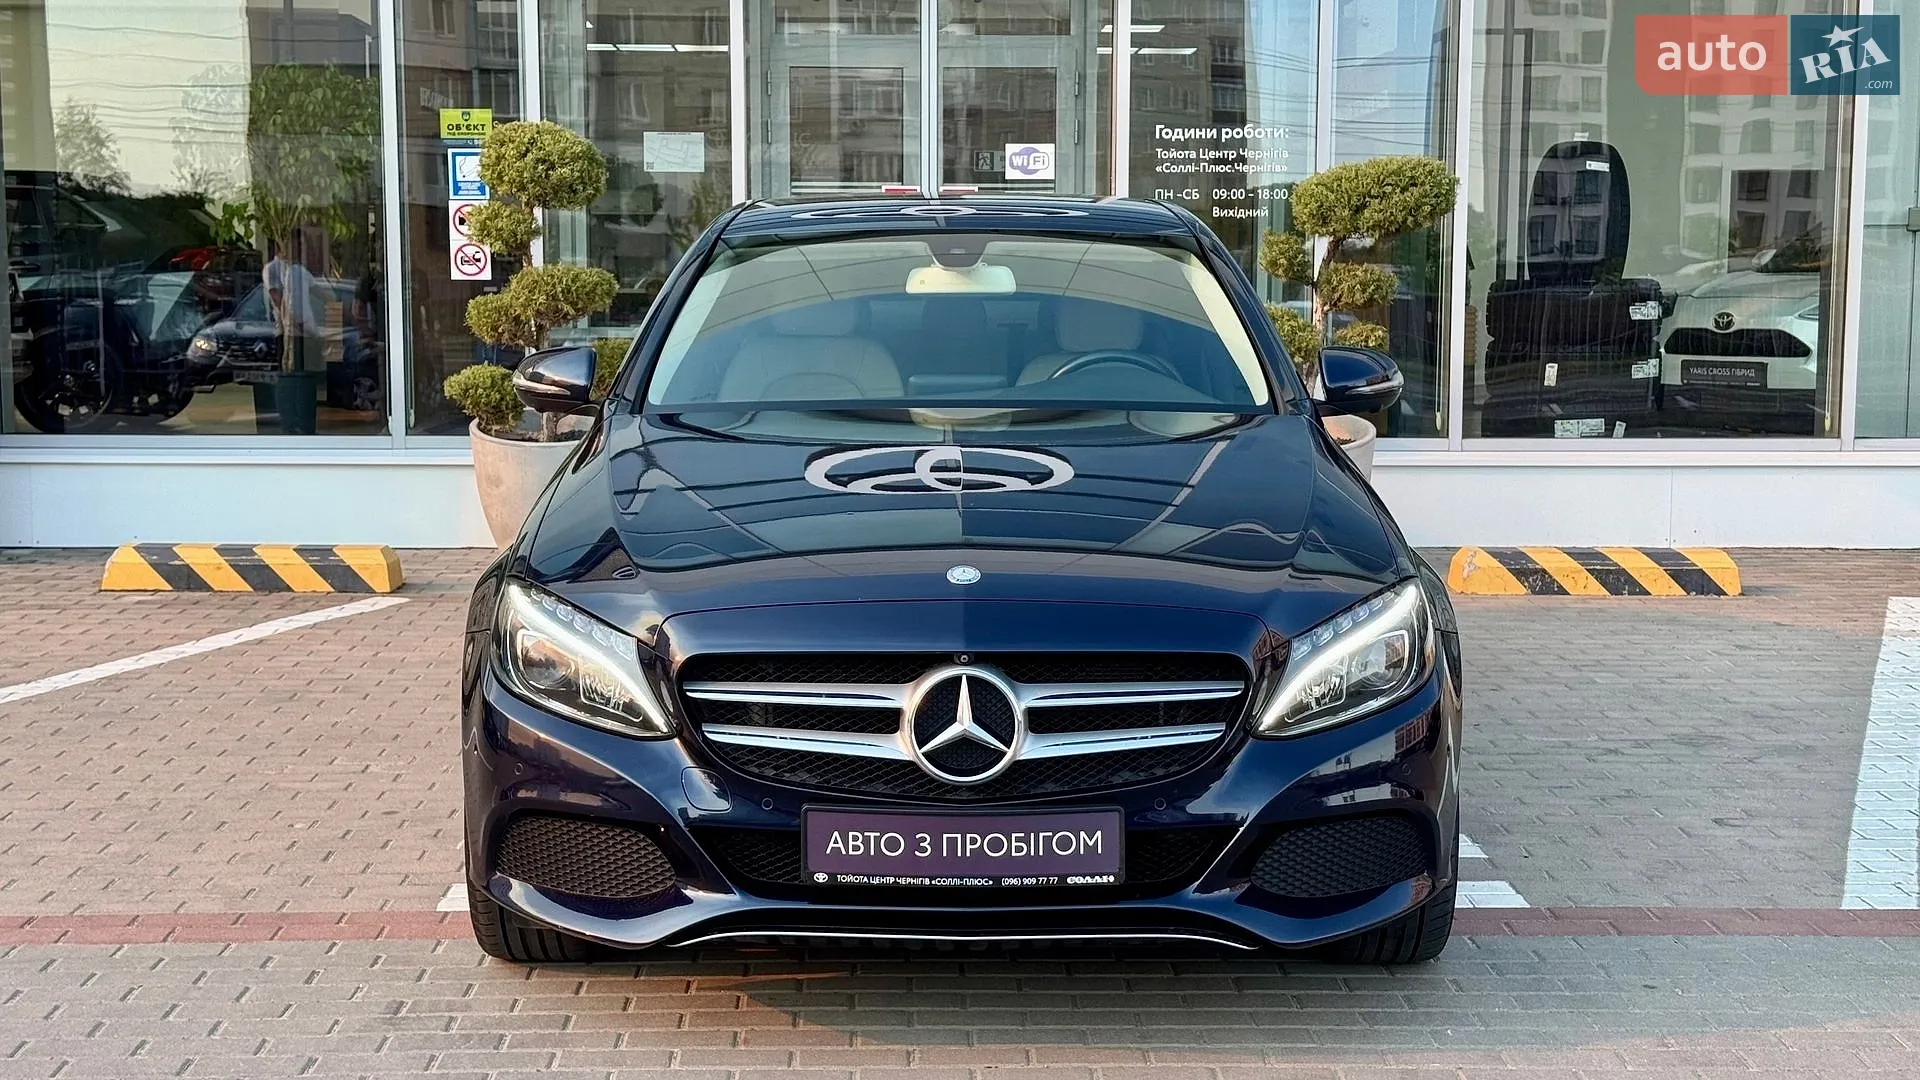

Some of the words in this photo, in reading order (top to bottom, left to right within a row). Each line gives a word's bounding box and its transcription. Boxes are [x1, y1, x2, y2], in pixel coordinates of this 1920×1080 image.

[446, 123, 486, 131] ОБ'ЄКТ
[1155, 124, 1218, 142] Години
[1221, 123, 1289, 142] роботи:
[1155, 147, 1197, 159] Тойота
[1199, 148, 1237, 160] Центр
[1239, 147, 1289, 160] Чернігів
[1154, 188, 1174, 200] ПН
[1212, 188, 1246, 200] 09:00
[1257, 188, 1289, 200] 18:00
[1212, 206, 1269, 219] Вихідний
[1689, 367, 1707, 376] YARIS
[1708, 367, 1730, 376] CROSS
[826, 831, 905, 857] АВТО
[942, 830, 1102, 857] ПРОБІГОМ
[836, 874, 869, 884] ТОЙОТА
[870, 876, 895, 885] ЦЕНТР
[896, 877, 931, 885] ЧЕРНІГІВ
[1001, 876, 1022, 886] (096)
[1022, 877, 1037, 885] 909
[1038, 876, 1048, 885] 77
[1048, 876, 1059, 885] 77
